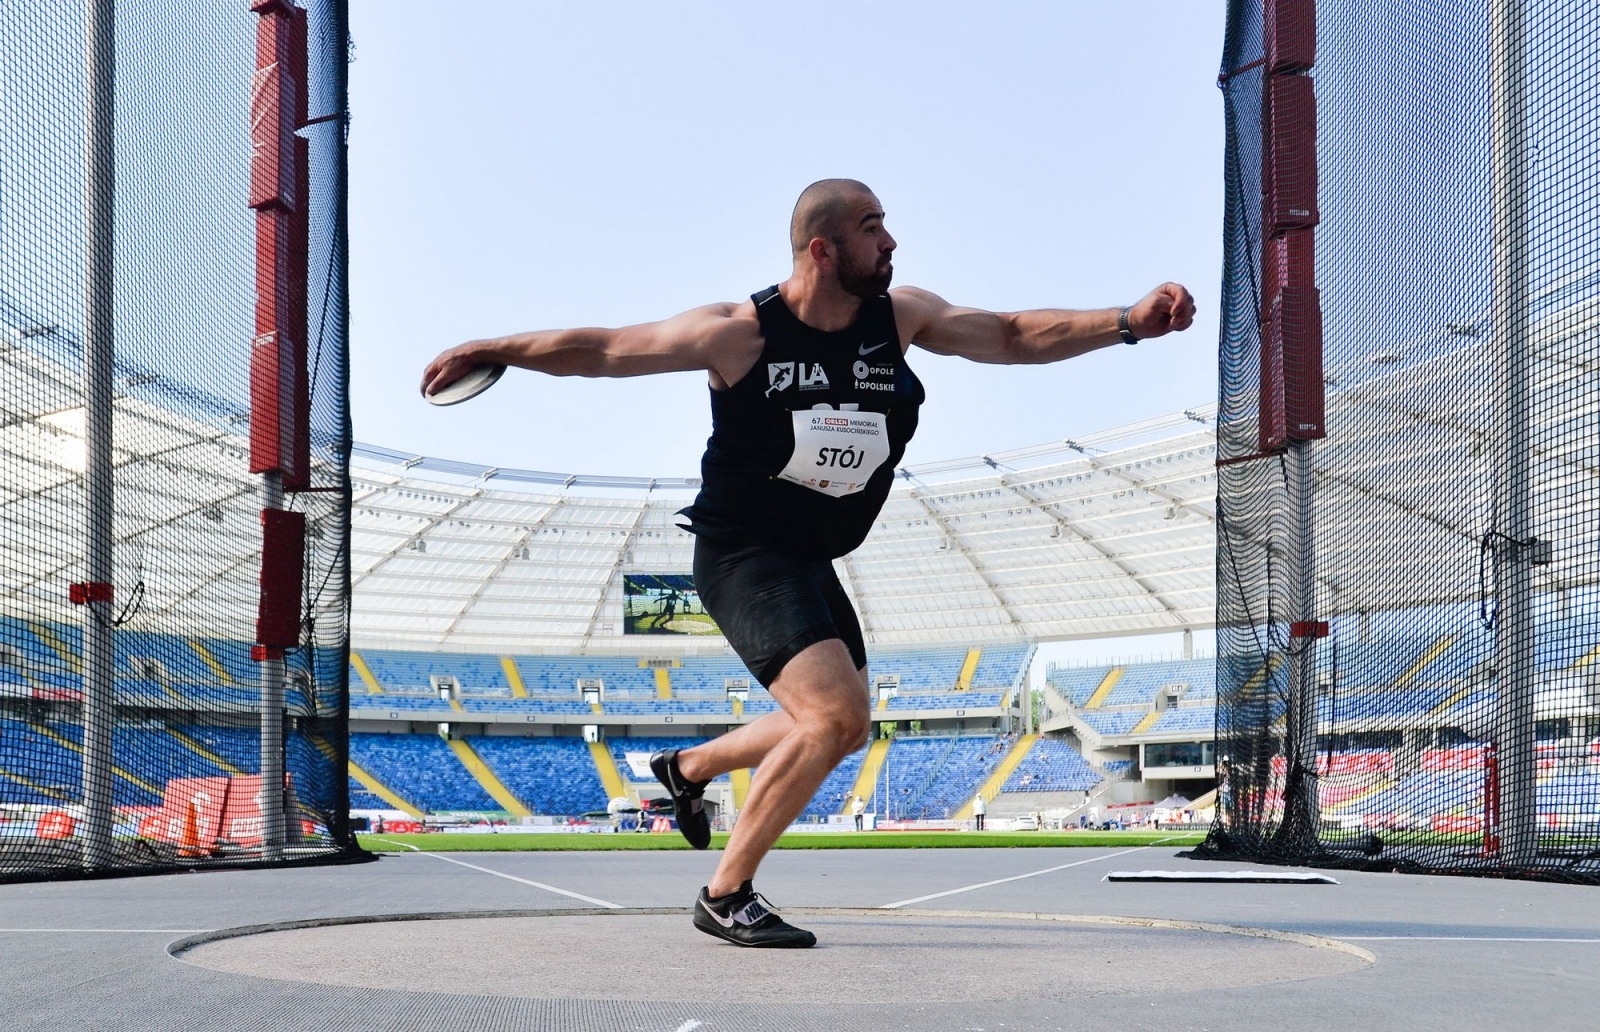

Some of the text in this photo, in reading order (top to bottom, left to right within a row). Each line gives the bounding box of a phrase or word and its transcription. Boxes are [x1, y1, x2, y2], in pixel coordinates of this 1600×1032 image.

[798, 363, 830, 385] LA
[869, 367, 895, 375] OPOLE
[859, 381, 895, 392] OPOLSKIE
[811, 417, 878, 428] 67. ORLEN MEMORIAŁ
[836, 427, 880, 436] KUSOCIŃSKIEGO
[815, 445, 865, 469] STÓJ
